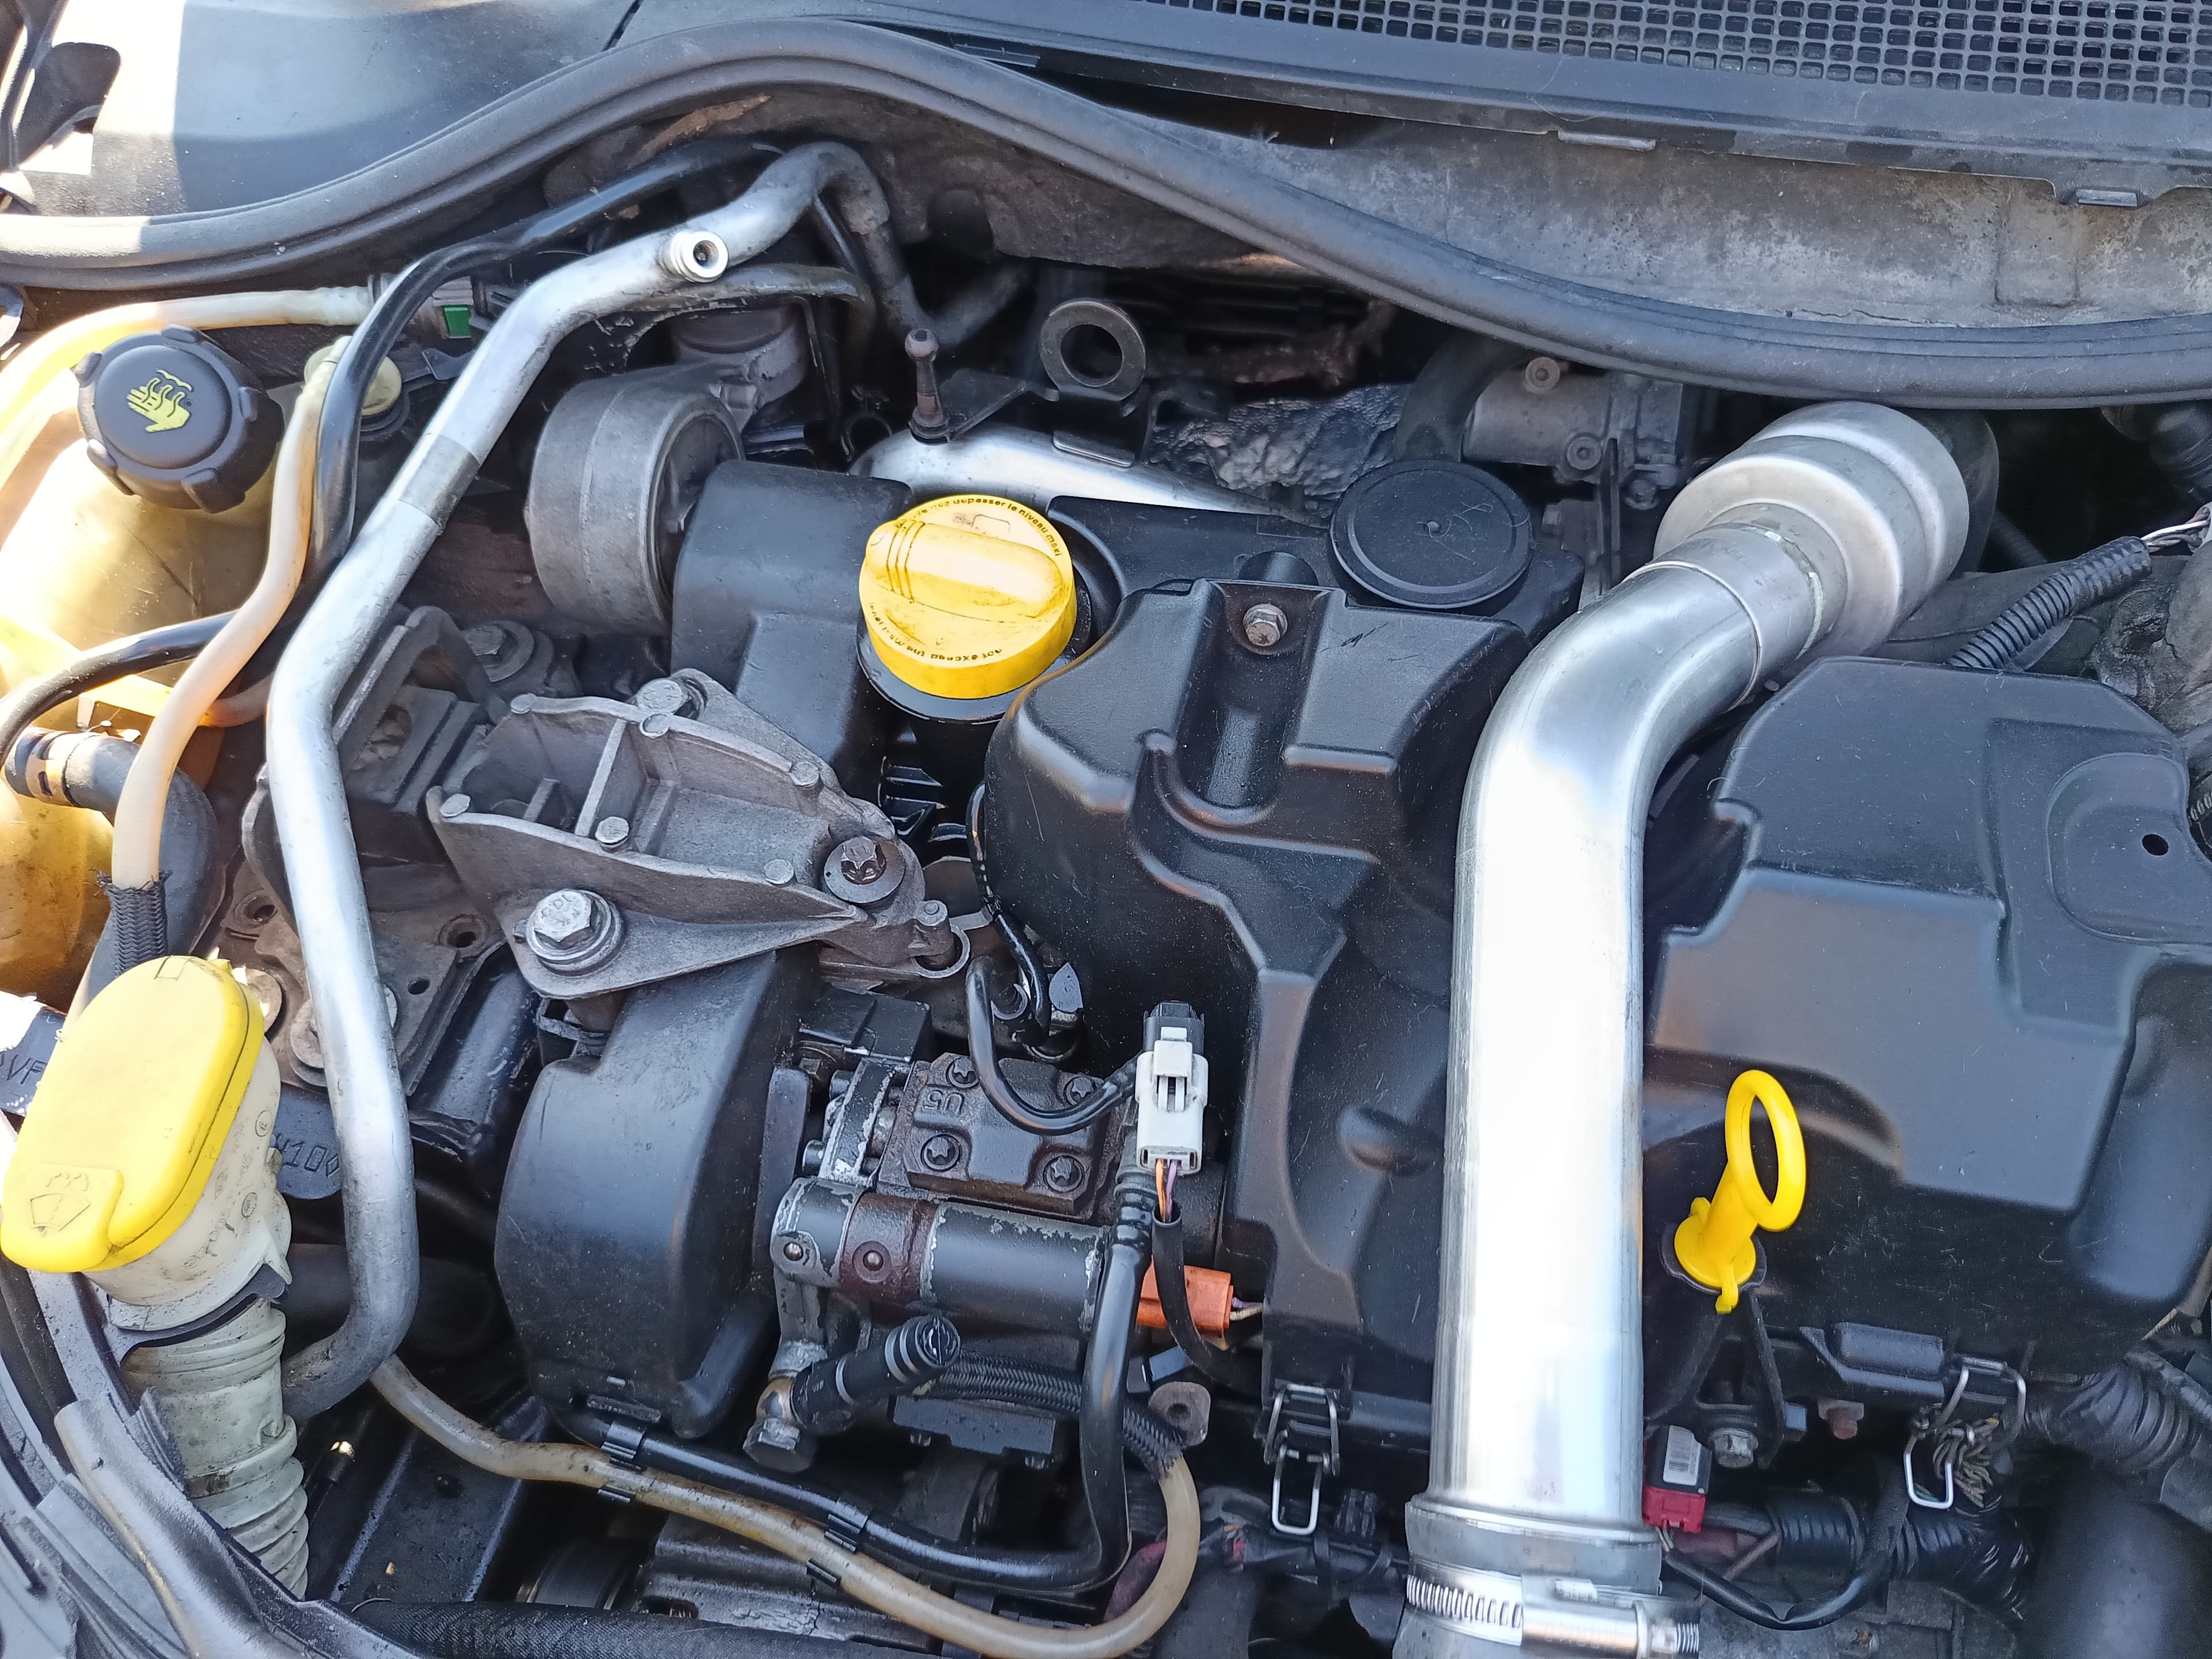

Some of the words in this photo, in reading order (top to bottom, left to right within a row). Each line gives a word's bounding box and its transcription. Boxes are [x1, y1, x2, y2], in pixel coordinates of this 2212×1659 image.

[1007, 503, 1017, 512] le
[1018, 509, 1048, 534] niveau
[1046, 533, 1063, 556] maxi
